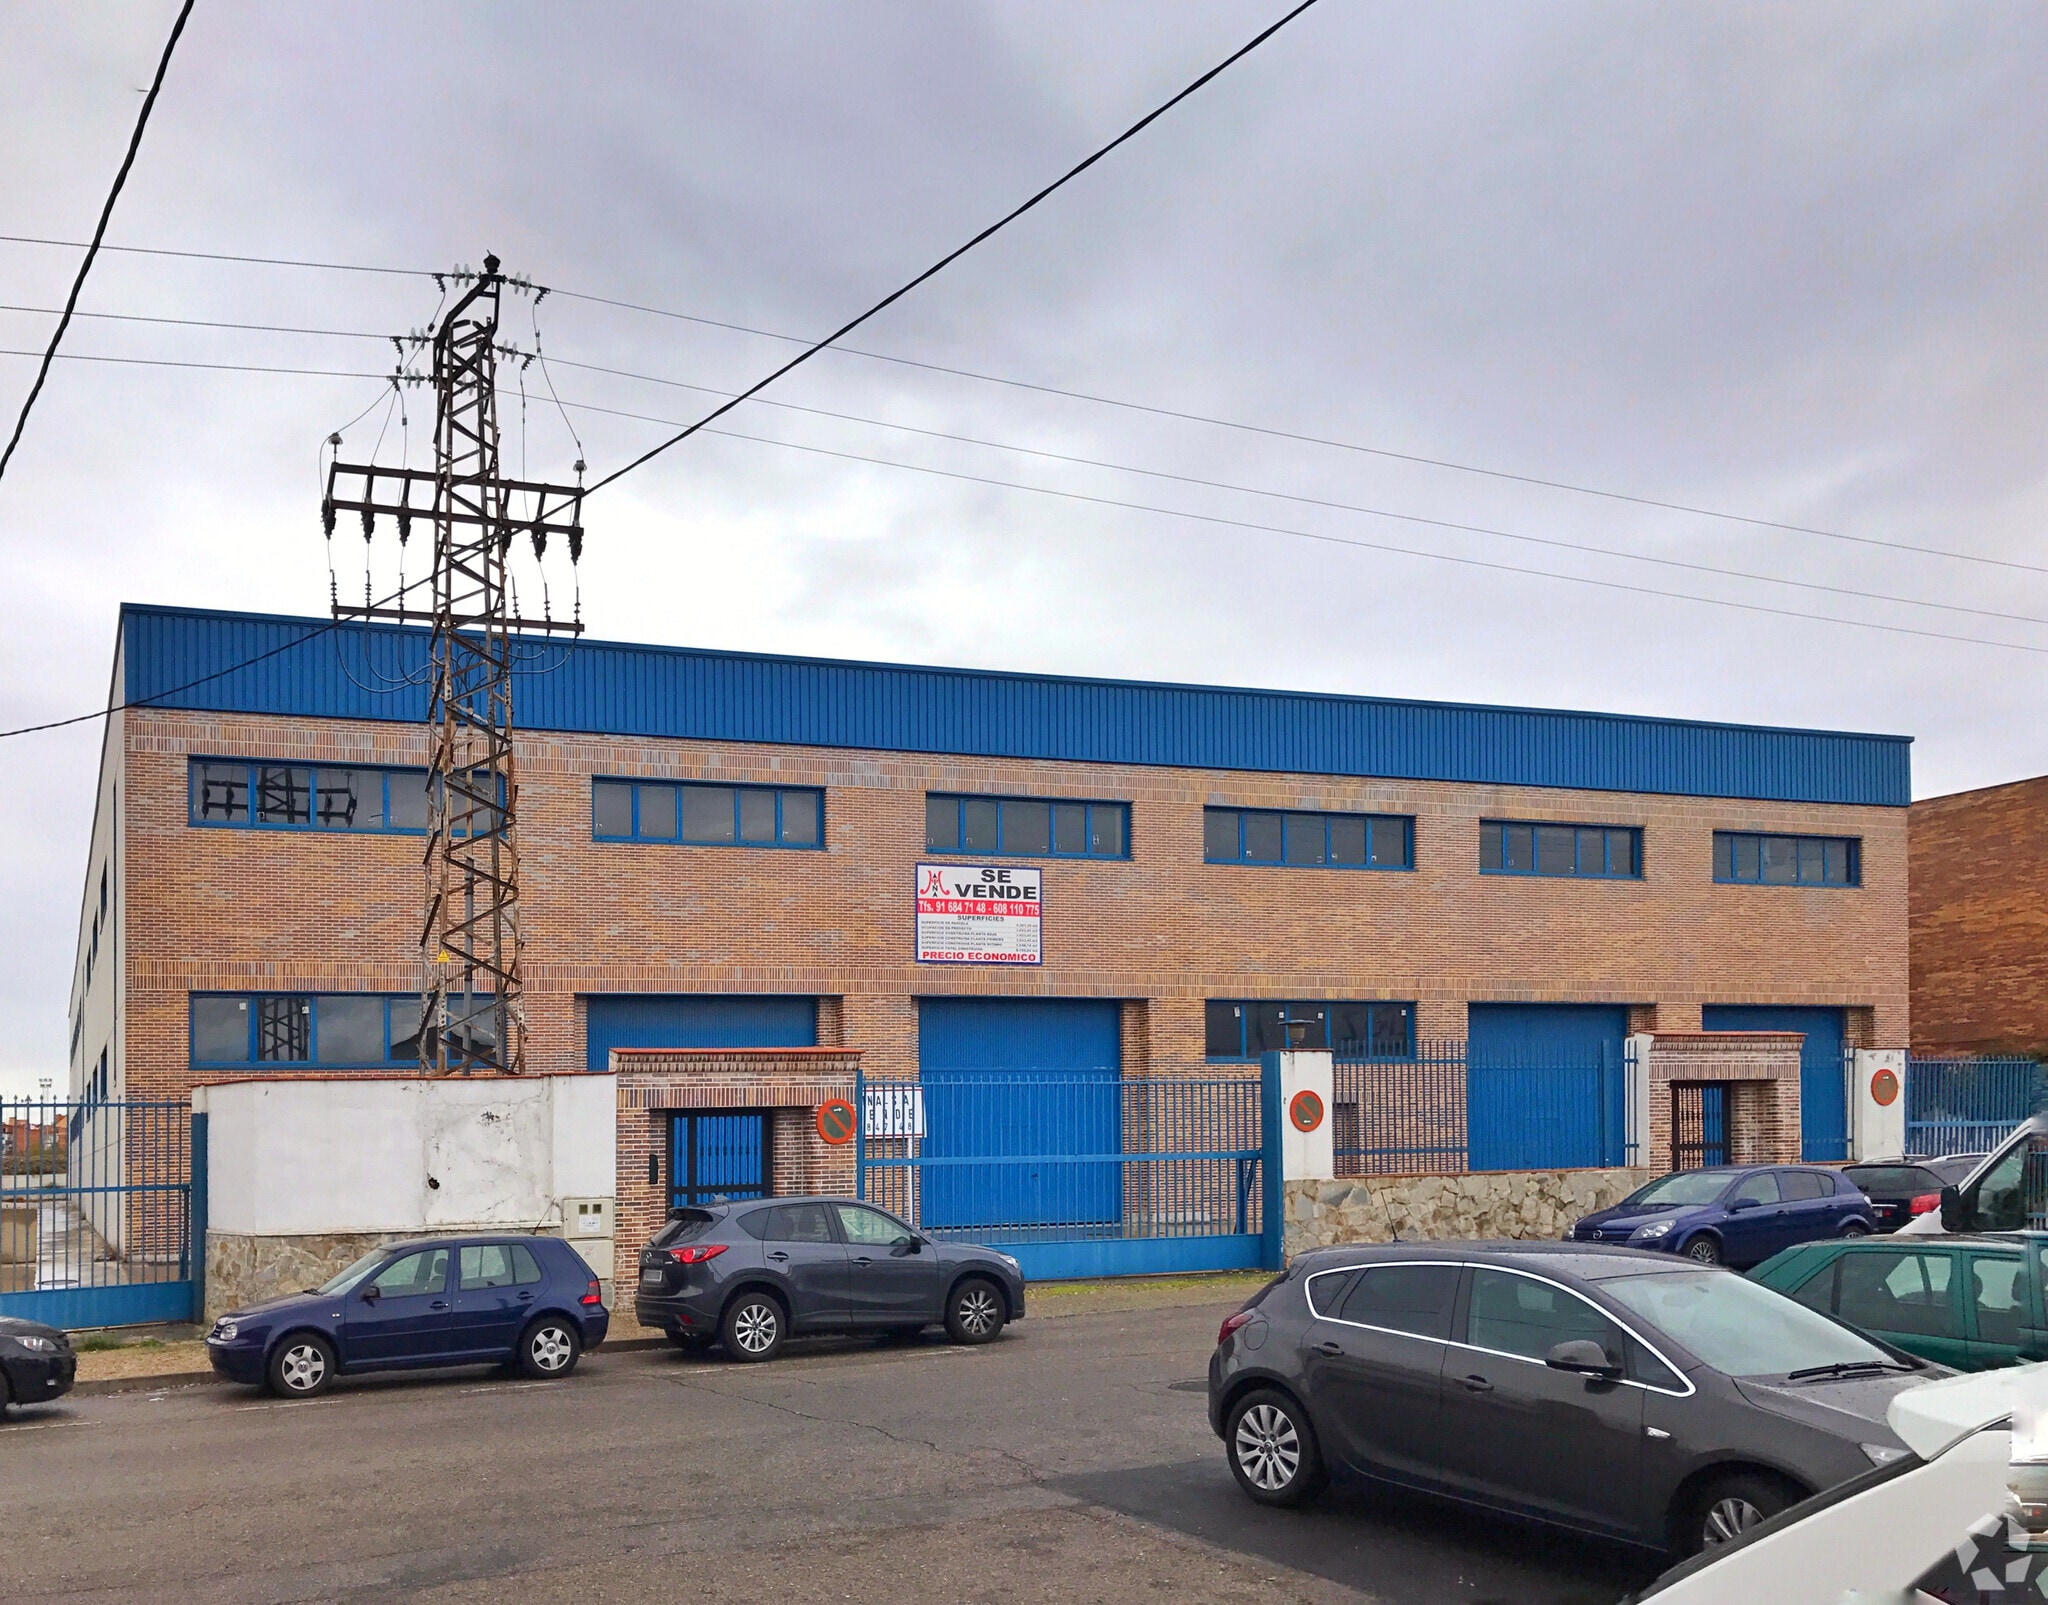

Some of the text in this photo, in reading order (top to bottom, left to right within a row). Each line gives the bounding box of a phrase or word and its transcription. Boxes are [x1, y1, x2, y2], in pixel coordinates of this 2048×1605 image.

[980, 869, 1012, 884] SE
[954, 883, 1037, 900] VENDE
[918, 901, 934, 912] Tfs.
[935, 901, 945, 912] 91
[947, 901, 963, 913] 684
[964, 902, 974, 913] 71
[976, 902, 986, 913] 48
[993, 902, 1008, 914] 608
[1009, 903, 1024, 915] 110
[1025, 904, 1040, 916] 775
[922, 951, 1036, 961] PRECIO ECONOMICO
